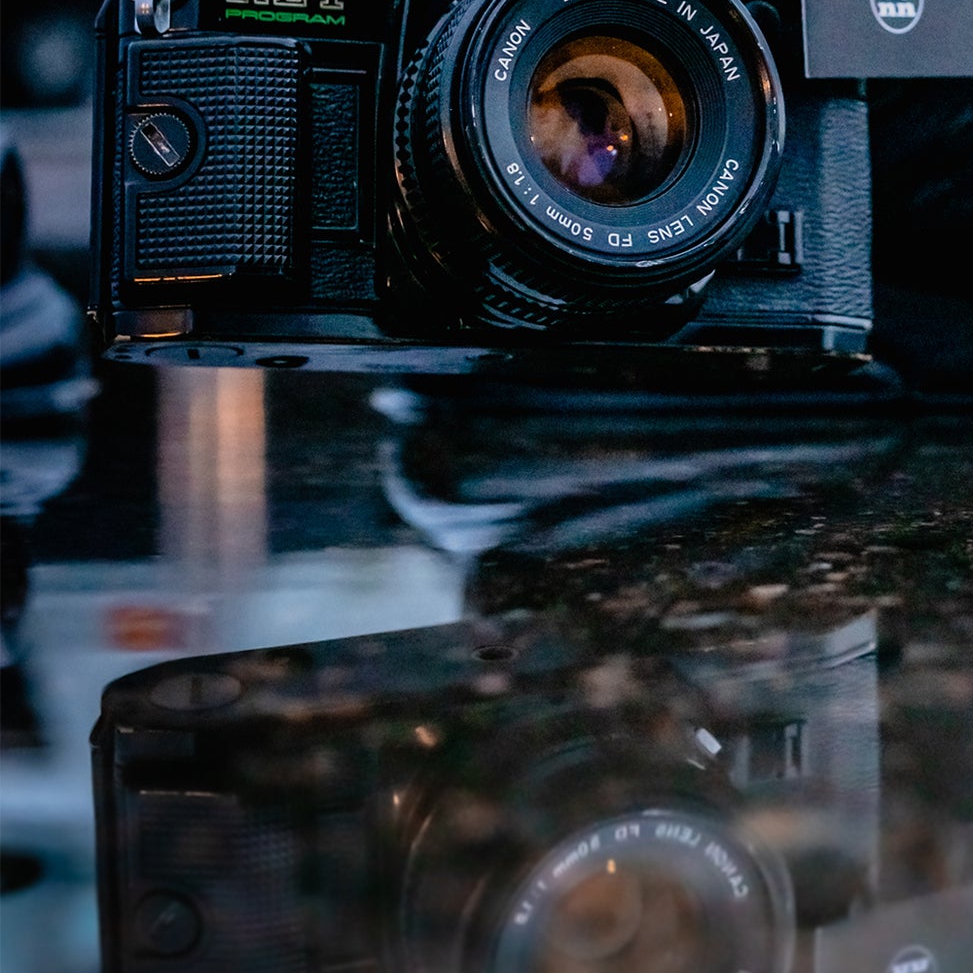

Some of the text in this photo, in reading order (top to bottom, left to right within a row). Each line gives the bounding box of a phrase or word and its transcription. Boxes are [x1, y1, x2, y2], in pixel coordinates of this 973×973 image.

[225, 9, 345, 25] PROGRAM
[494, 19, 531, 82] CANON
[677, 0, 697, 21] IN
[700, 26, 740, 82] JAPAN
[696, 158, 740, 216] CANON
[546, 205, 594, 241] 50mm
[647, 214, 694, 244] LENS
[608, 233, 633, 247] FD
